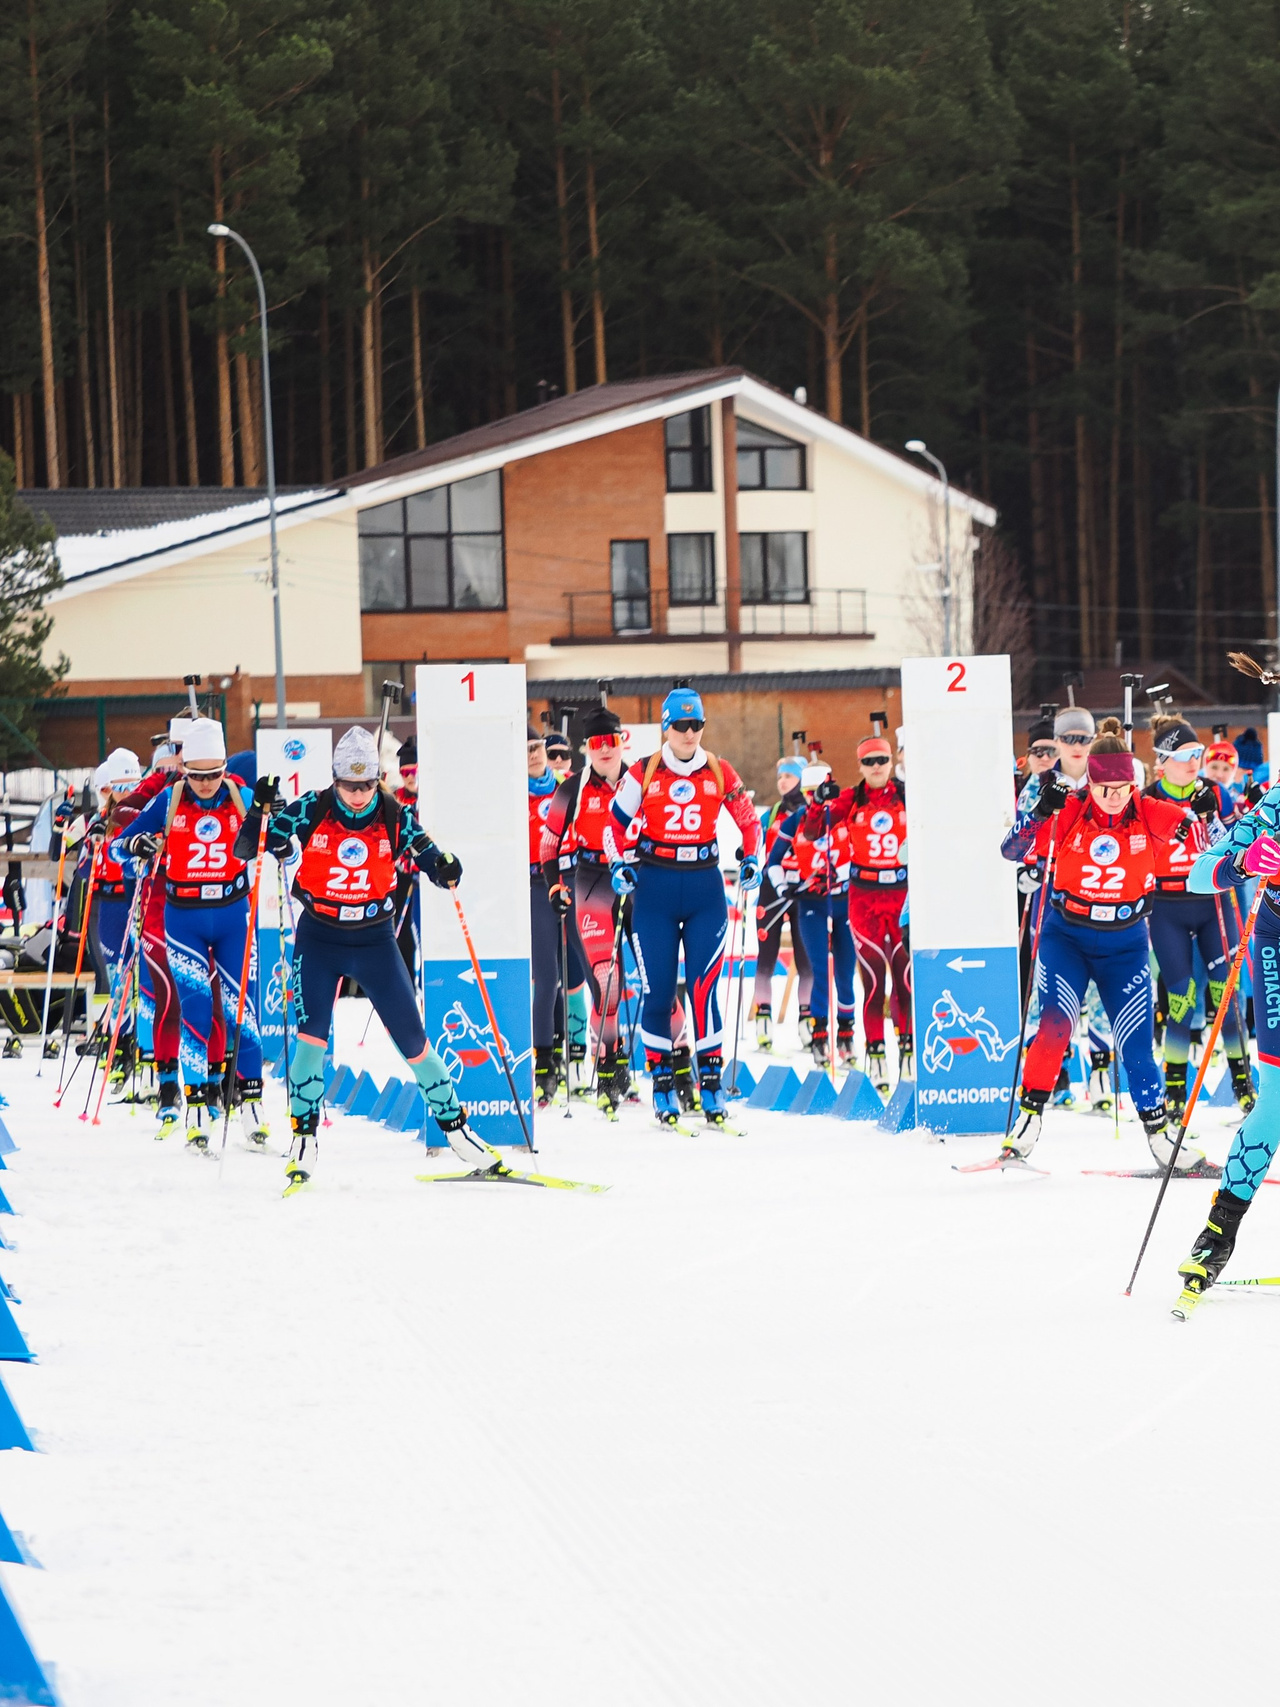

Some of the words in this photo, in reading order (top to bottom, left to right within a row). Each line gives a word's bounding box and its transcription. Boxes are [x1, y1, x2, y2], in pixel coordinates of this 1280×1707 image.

[461, 671, 475, 701] 1
[946, 662, 967, 692] 2
[288, 772, 300, 796] 1
[664, 804, 702, 831] 26
[187, 843, 228, 869] 25
[867, 834, 898, 857] 39
[326, 867, 371, 890] 21
[1081, 865, 1126, 890] 22
